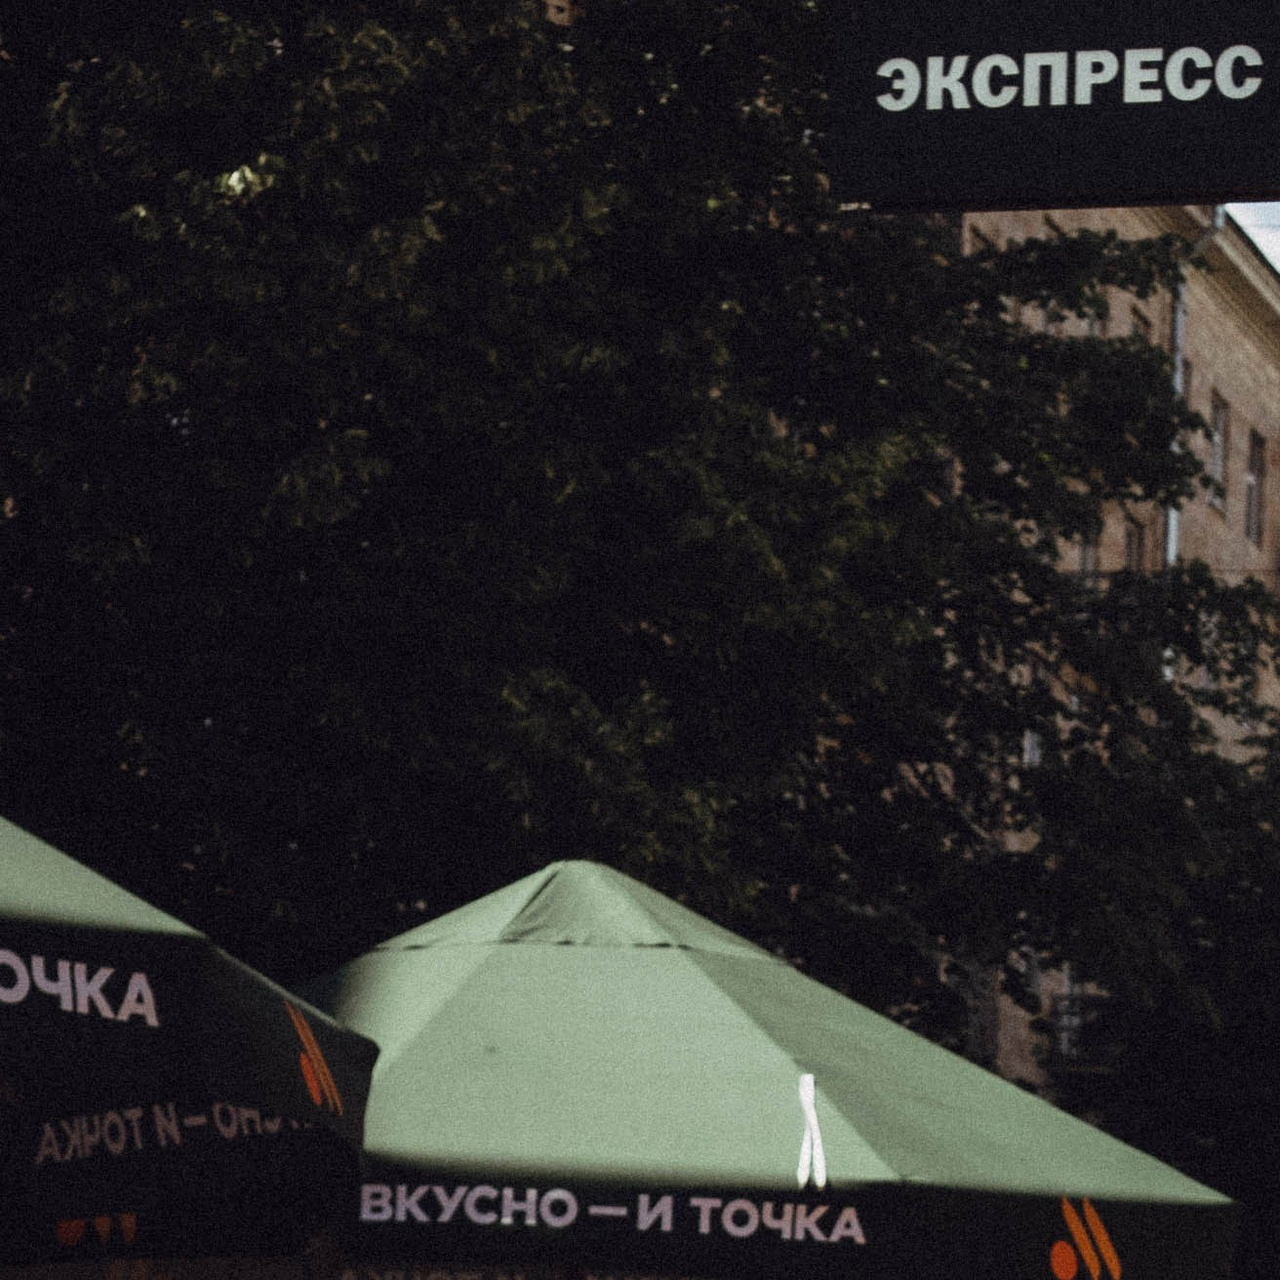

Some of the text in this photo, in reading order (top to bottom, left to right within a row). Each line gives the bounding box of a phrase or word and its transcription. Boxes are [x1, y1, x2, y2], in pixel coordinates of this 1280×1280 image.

[875, 44, 1264, 112] ЭКСПРЕСС
[360, 1184, 579, 1229] ВКУСНО
[636, 1193, 674, 1232] И
[689, 1197, 867, 1245] ТОЧКА
